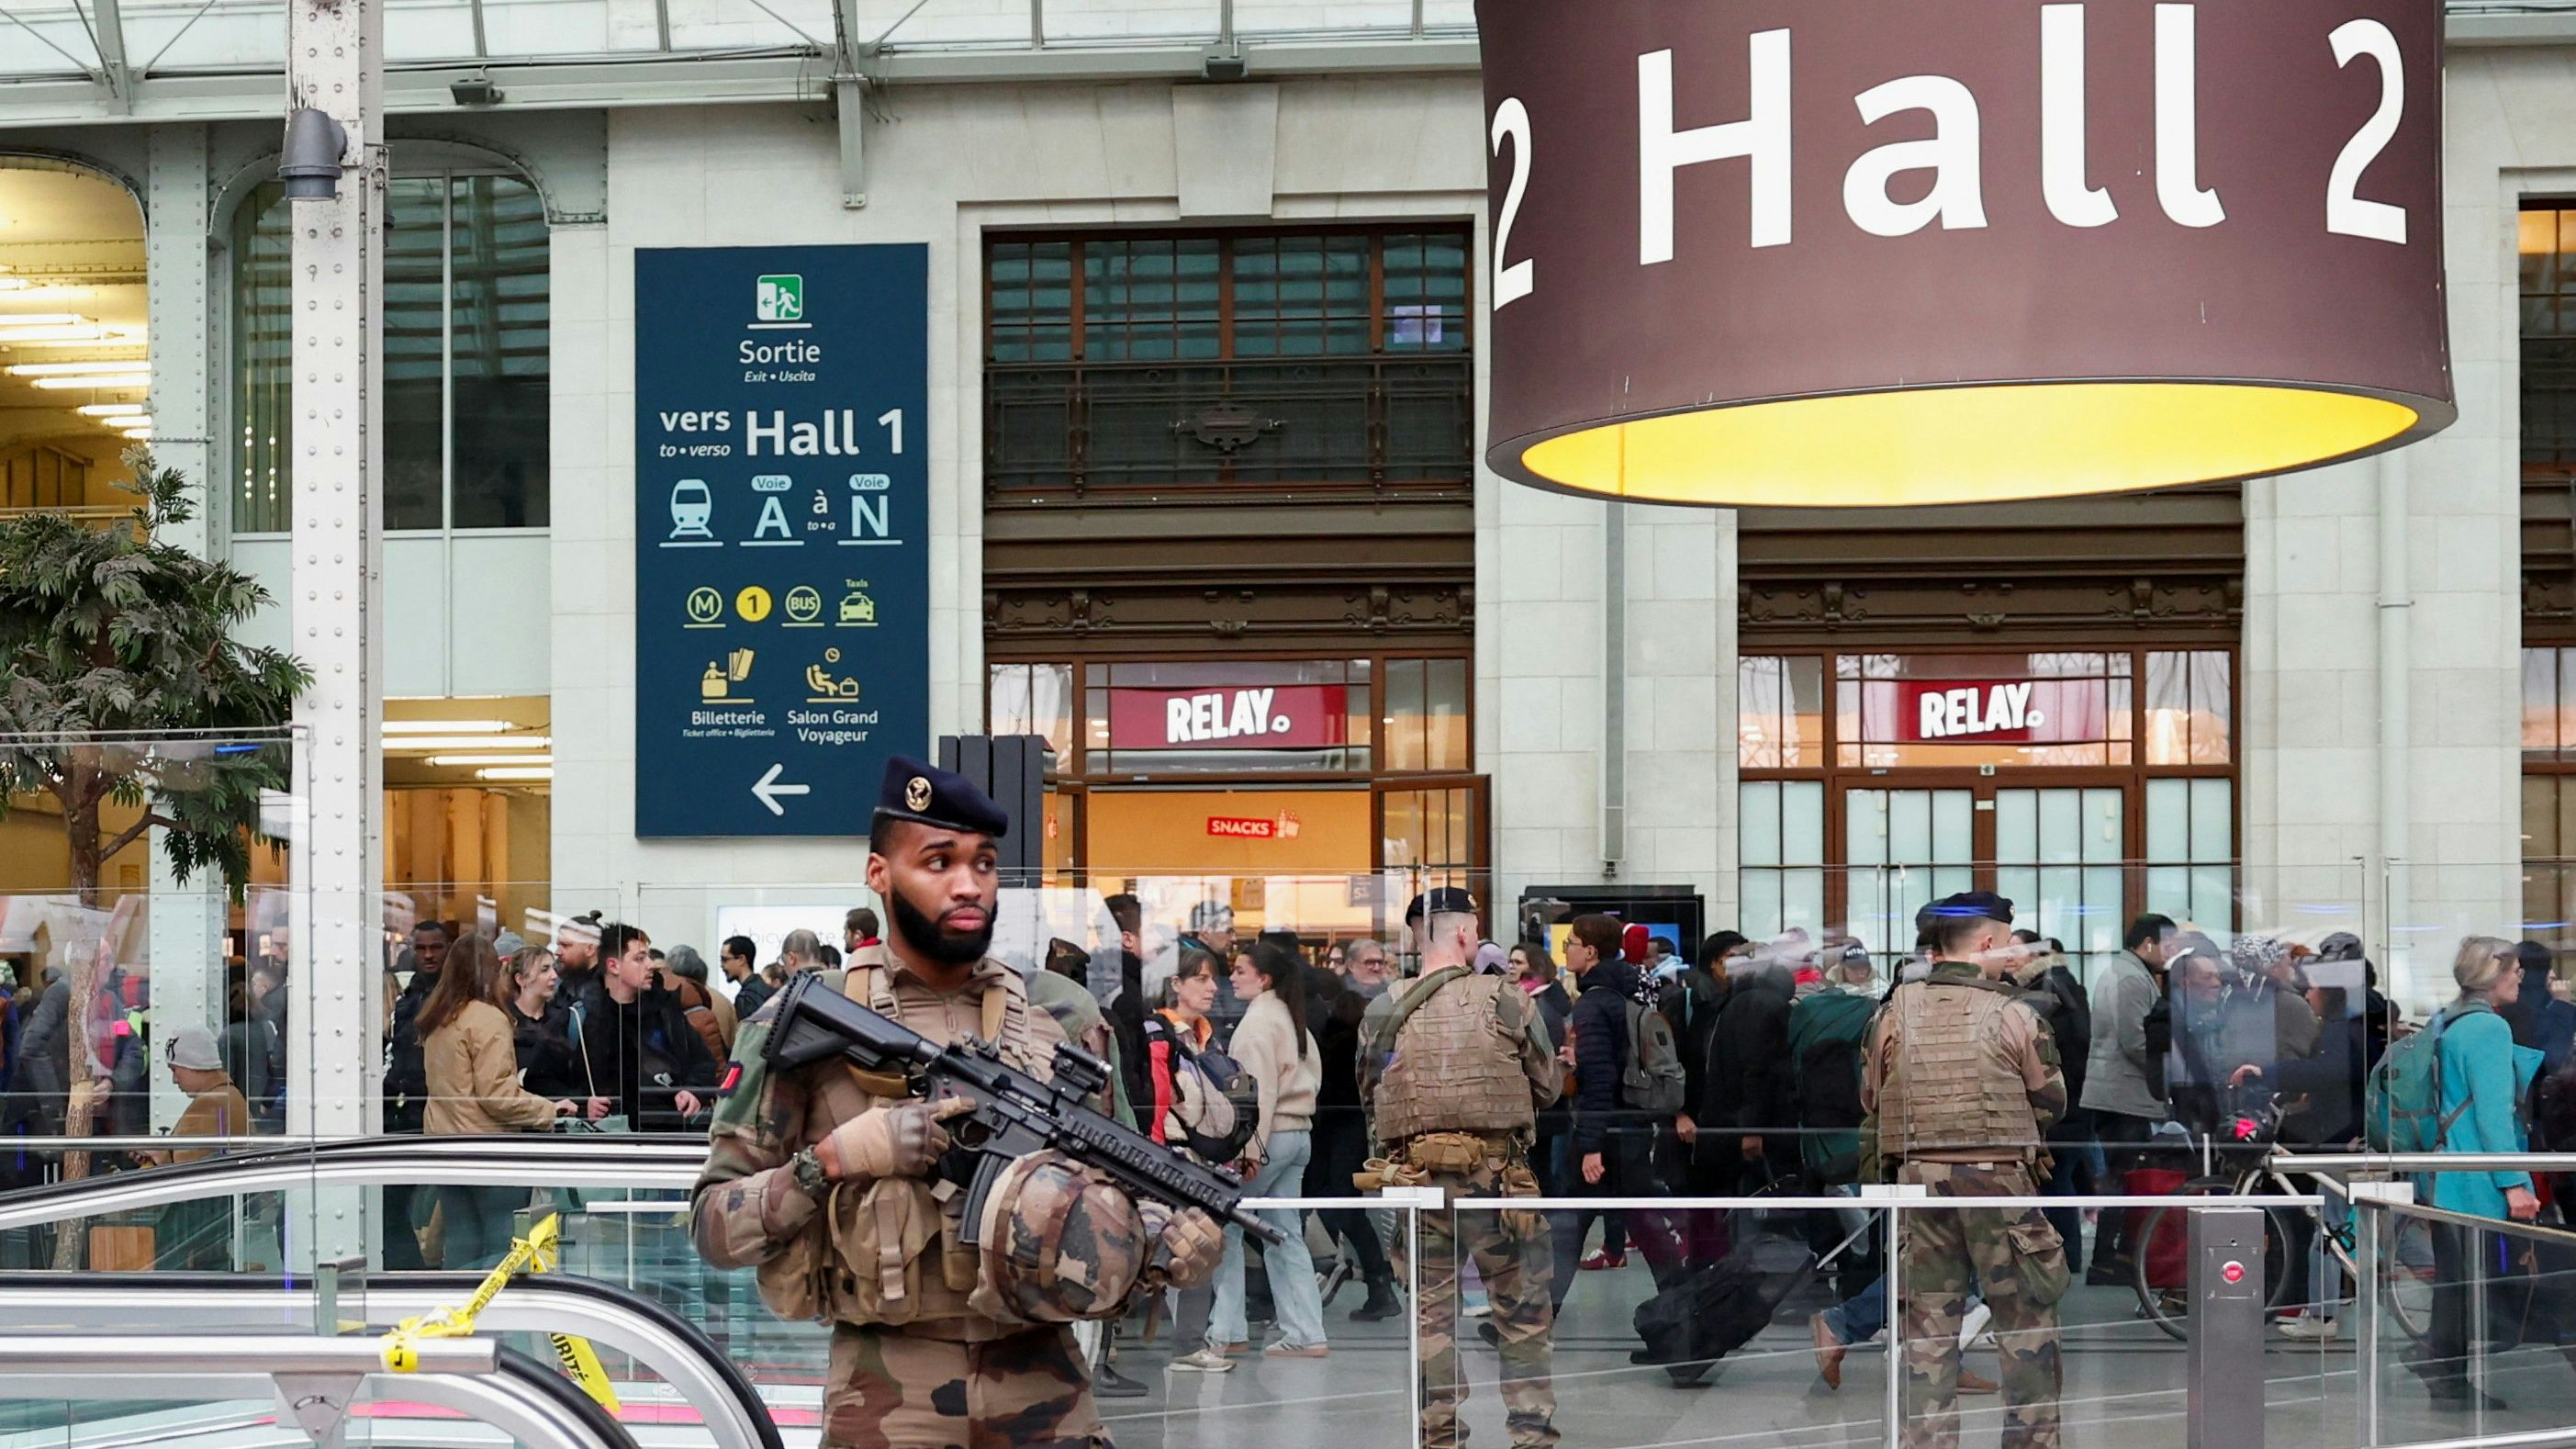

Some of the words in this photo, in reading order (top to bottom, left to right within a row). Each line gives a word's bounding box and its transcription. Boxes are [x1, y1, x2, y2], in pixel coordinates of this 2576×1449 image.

[1639, 3, 2226, 265] Hall
[2326, 18, 2407, 244] 2
[1491, 96, 1533, 312] 2
[739, 339, 821, 364] Sortie
[744, 370, 767, 383] Exit
[778, 370, 816, 383] Uscita
[659, 410, 731, 432] vers
[746, 410, 860, 455] Hall
[878, 409, 902, 454] 1
[659, 444, 677, 457] to
[689, 444, 731, 457] verso
[757, 477, 786, 489] Voie
[855, 476, 884, 488] Voie
[754, 496, 792, 538] A
[812, 489, 828, 514] à
[851, 495, 889, 537] N
[807, 521, 819, 531] to
[827, 522, 836, 531] a
[846, 578, 868, 588] Taxis
[695, 595, 714, 614] M
[747, 594, 757, 614] 1
[790, 597, 816, 611] BUS
[691, 711, 766, 725] Billetterie
[787, 710, 828, 724] Salon
[833, 710, 879, 724] Grand
[797, 728, 868, 746] Voyageur
[1212, 820, 1270, 836] SNACKS
